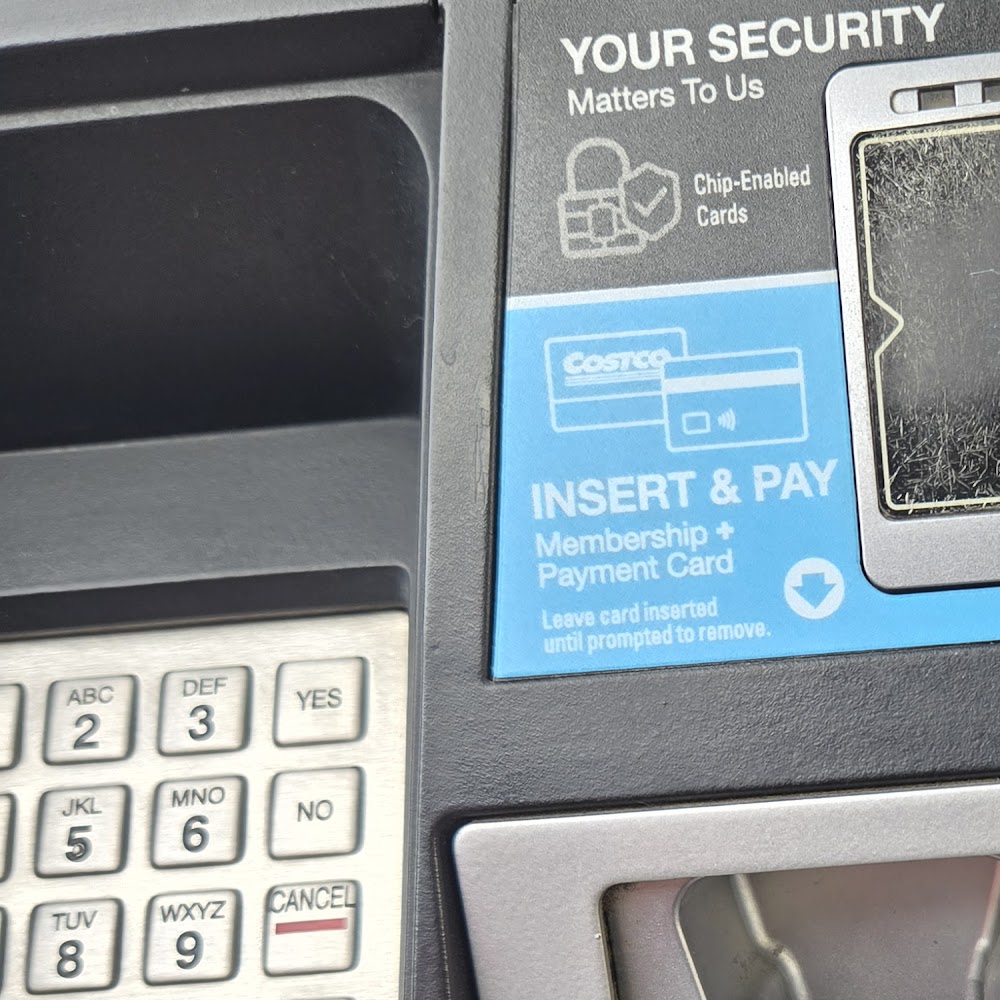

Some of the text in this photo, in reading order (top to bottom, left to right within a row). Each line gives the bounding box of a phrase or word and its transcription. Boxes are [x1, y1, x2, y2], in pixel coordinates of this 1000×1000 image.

[560, 3, 946, 76] YOUR SECURITY
[568, 74, 764, 116] Matters To Us
[694, 165, 811, 197] Chip-Enabled
[697, 204, 748, 228] Cards
[563, 347, 672, 375] COSTCO
[531, 459, 838, 520] INSERT & PAY
[535, 521, 734, 557] Membership +
[538, 549, 734, 592] Payment Card
[542, 596, 718, 630] Leave card inserted
[544, 621, 771, 655] until prompted to remove.
[67, 686, 114, 706] ABC
[182, 677, 228, 697] DEF
[297, 688, 343, 711] YES
[73, 713, 100, 750] 2
[188, 704, 215, 741] 3
[62, 797, 102, 818] JKL
[172, 786, 226, 808] MNO
[297, 799, 334, 822] NO
[65, 825, 92, 863] 5
[182, 815, 209, 853] 6
[160, 900, 226, 922] WXYZ
[269, 885, 357, 914] CANCEL
[52, 910, 98, 931] TUV
[56, 940, 84, 979] 8
[175, 930, 204, 969] 9
